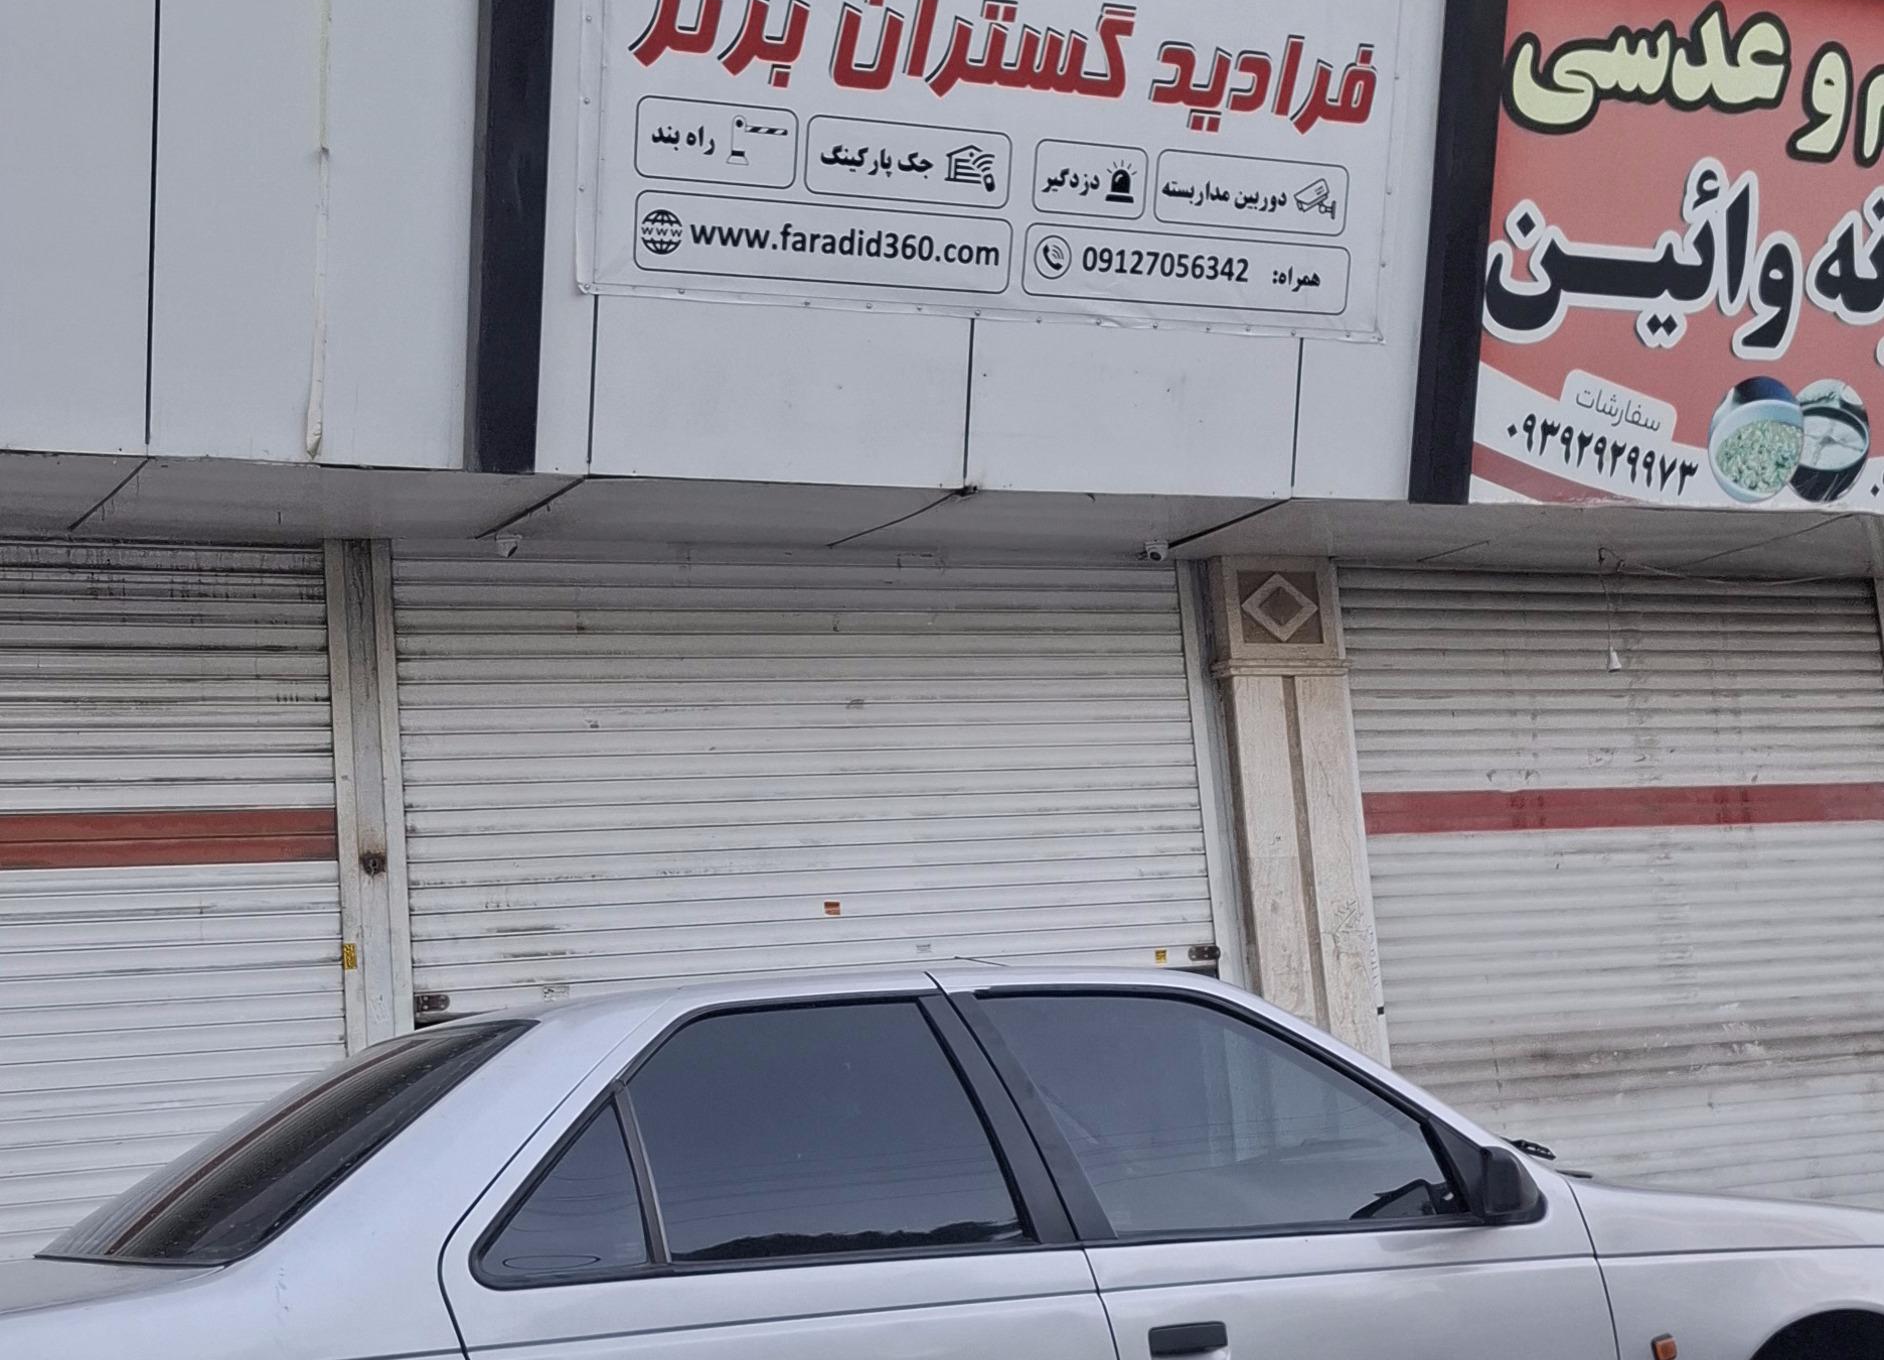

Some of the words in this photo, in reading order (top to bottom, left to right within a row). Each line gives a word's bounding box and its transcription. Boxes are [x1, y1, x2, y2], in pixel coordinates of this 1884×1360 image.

[1149, 35, 1378, 134] فرادید
[1504, 3, 1790, 133] عدسی
[1788, 42, 1853, 161] و
[651, 125, 681, 152] بند
[685, 125, 716, 156] راه
[820, 144, 893, 178] پارکینگ
[897, 151, 934, 180] جک
[1041, 167, 1102, 197] دزدگیر
[1161, 180, 1230, 207] مداربسته
[1234, 190, 1288, 213] دوربین
[689, 222, 1001, 267] www.faradid360.com
[1082, 246, 1250, 283] 09127056342
[1271, 266, 1322, 293] همراه:
[1575, 388, 1661, 433] سفارشات
[1507, 413, 1699, 496] ۰۹۳۹۲۹۲۹۹۷۳
